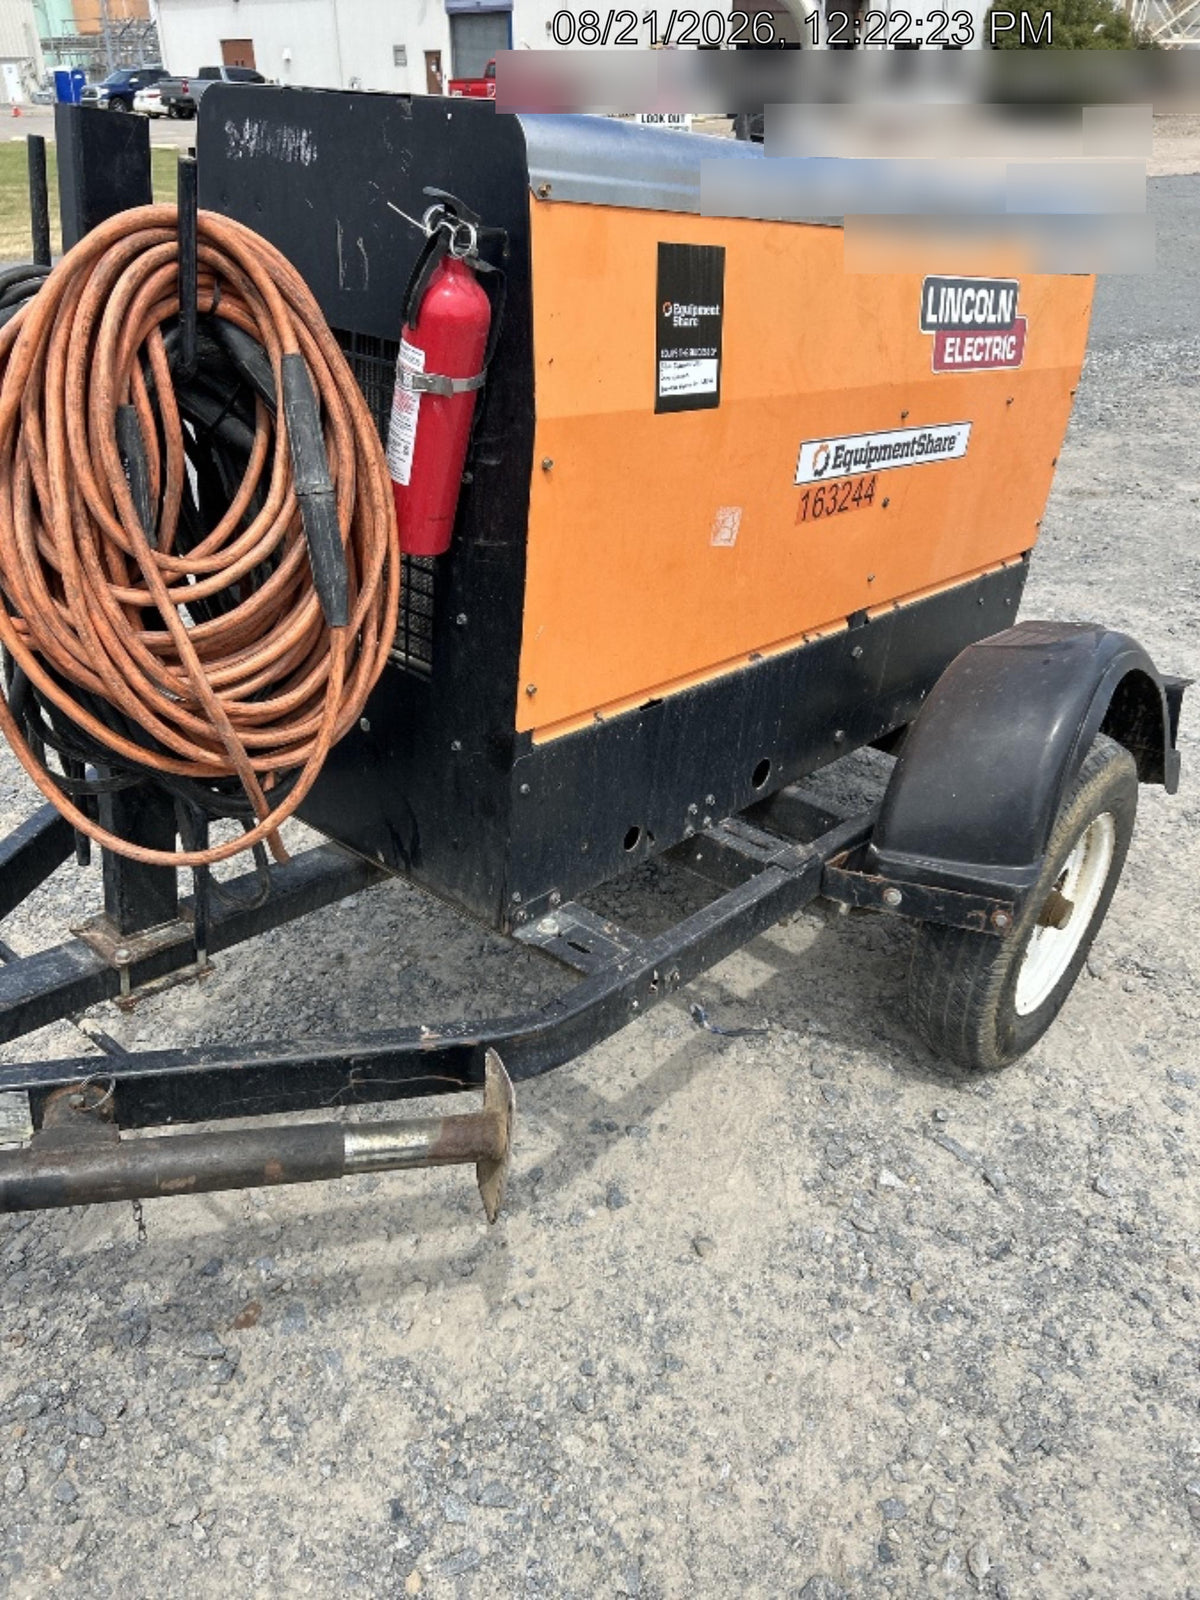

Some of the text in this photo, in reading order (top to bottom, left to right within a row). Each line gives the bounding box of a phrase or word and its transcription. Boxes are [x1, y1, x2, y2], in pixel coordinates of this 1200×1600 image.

[641, 113, 686, 124] LOOK OUT
[673, 303, 720, 317] Equipment
[926, 286, 1014, 324] LINCOLN
[943, 335, 1017, 363] ELECTRIC
[831, 433, 957, 473] EquipmentShare
[800, 475, 877, 522] 163244
